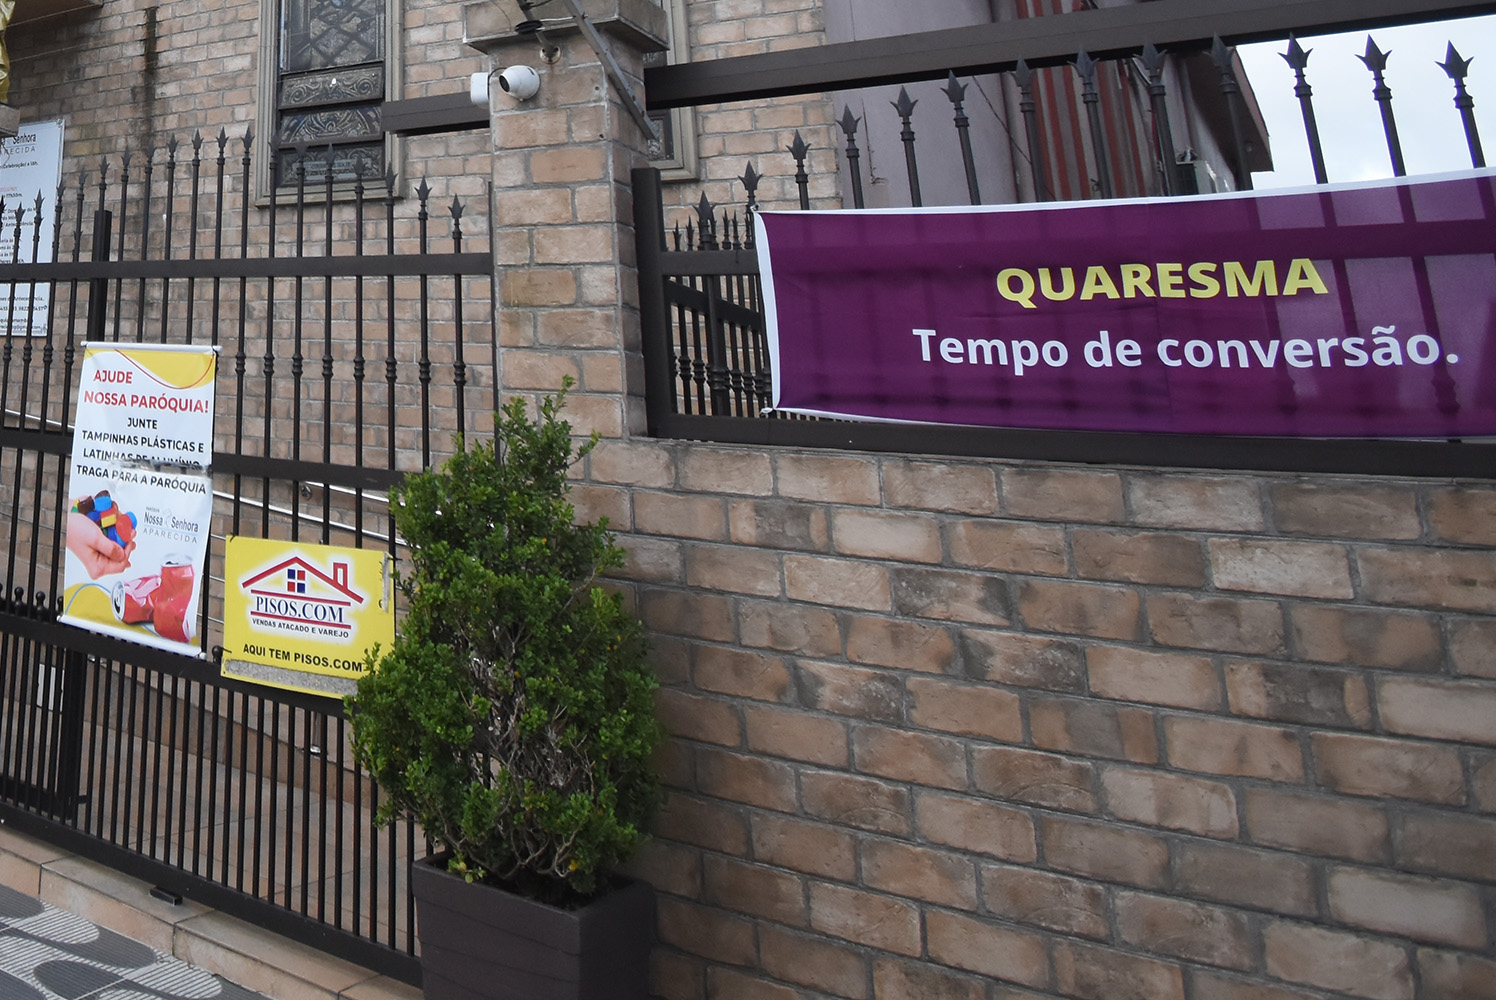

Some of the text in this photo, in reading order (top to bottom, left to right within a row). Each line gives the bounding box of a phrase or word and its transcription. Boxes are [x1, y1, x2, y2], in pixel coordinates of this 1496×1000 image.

[996, 258, 1329, 308] QUARESMA
[912, 325, 1460, 376] Tempo de conversão.
[93, 370, 133, 384] AJUDE
[84, 391, 209, 413] NOSSA PARÓQUIA!
[127, 417, 158, 429] JUNTE
[82, 430, 204, 453] TAMPINHAS PLÁSTICAS E
[83, 448, 133, 461] LATINHAS
[76, 465, 206, 494] TRAGA PARA A PARÓQUIA
[144, 511, 198, 532] Nossa Senhora
[143, 528, 197, 543] APARECIDA
[256, 596, 344, 623] PISOS.COM
[252, 618, 276, 628] VENDAS
[278, 622, 309, 633] ATACADO
[318, 628, 349, 638] VAREJO
[243, 643, 362, 672] AQUI TEM PISOS.COM
